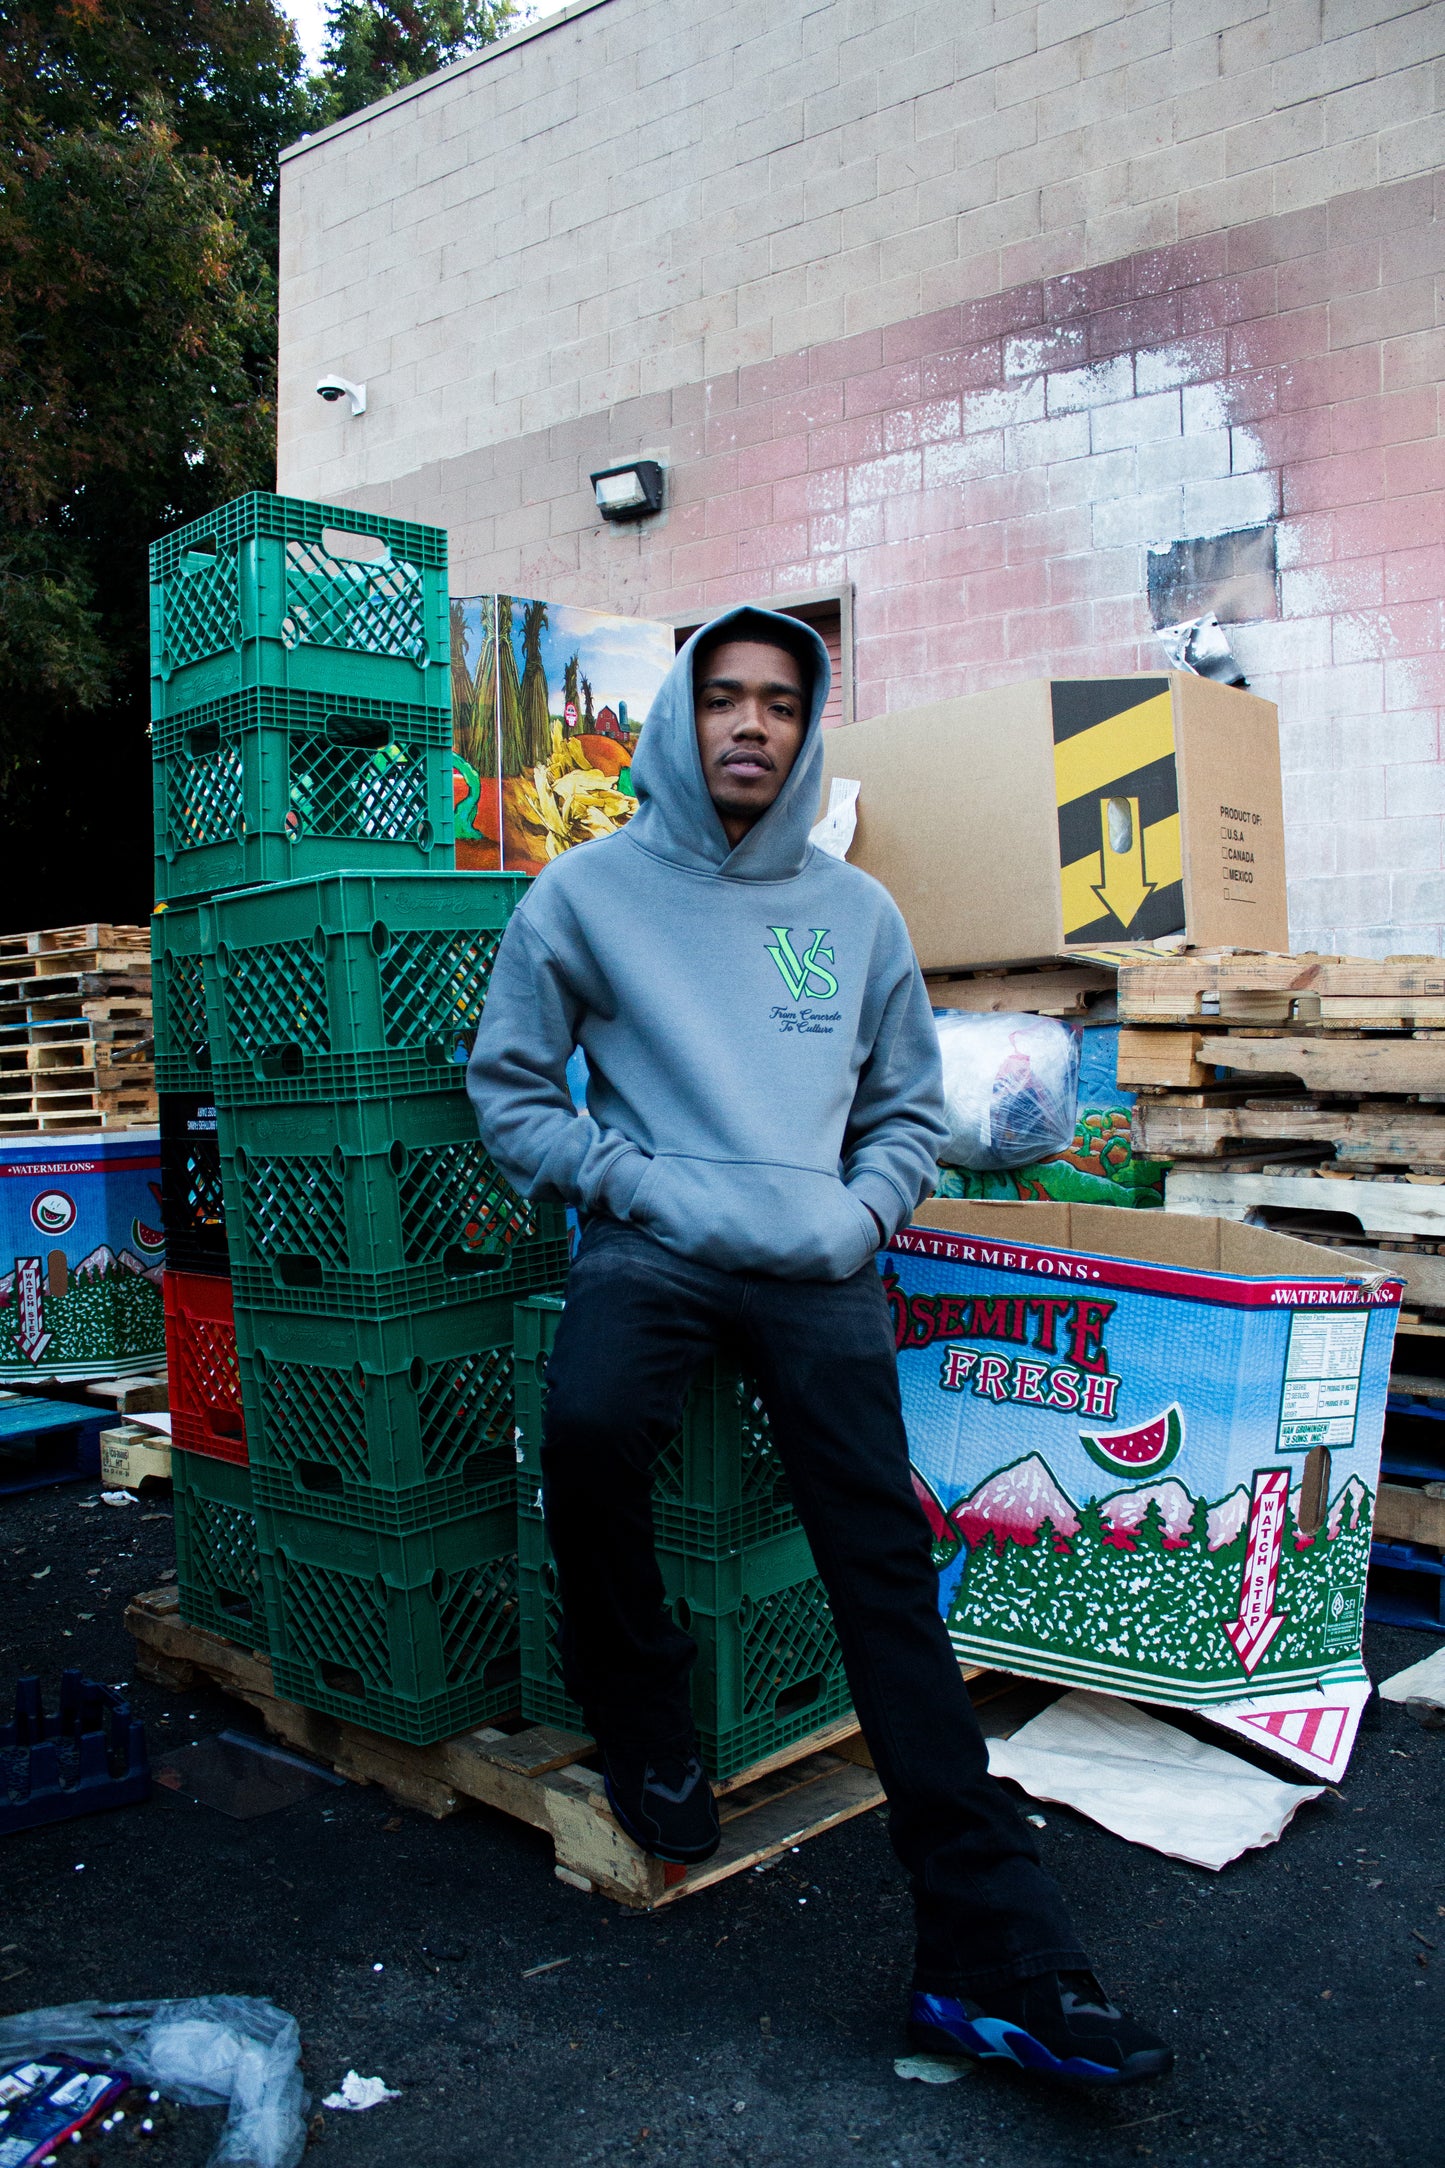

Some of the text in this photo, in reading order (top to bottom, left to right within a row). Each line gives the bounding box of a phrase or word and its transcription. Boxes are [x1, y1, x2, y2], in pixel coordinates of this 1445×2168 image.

[1220, 806, 1263, 826] PRODUCT OF:
[1228, 848, 1255, 863] CANADA
[1229, 868, 1254, 883] MEXICO
[769, 1006, 842, 1021] From Concrete
[779, 1020, 834, 1033] To Culture
[11, 1163, 91, 1175] WATERMELONS
[895, 1235, 1088, 1280] WATERMELONS
[25, 1272, 34, 1307] WATCH
[28, 1311, 36, 1339] STEP
[881, 1276, 1116, 1375] OSEMITE
[944, 1348, 1120, 1419] FRESH
[1257, 1501, 1275, 1566] WATCH
[1250, 1576, 1264, 1627] STEP
[1344, 1599, 1356, 1610] SFI
